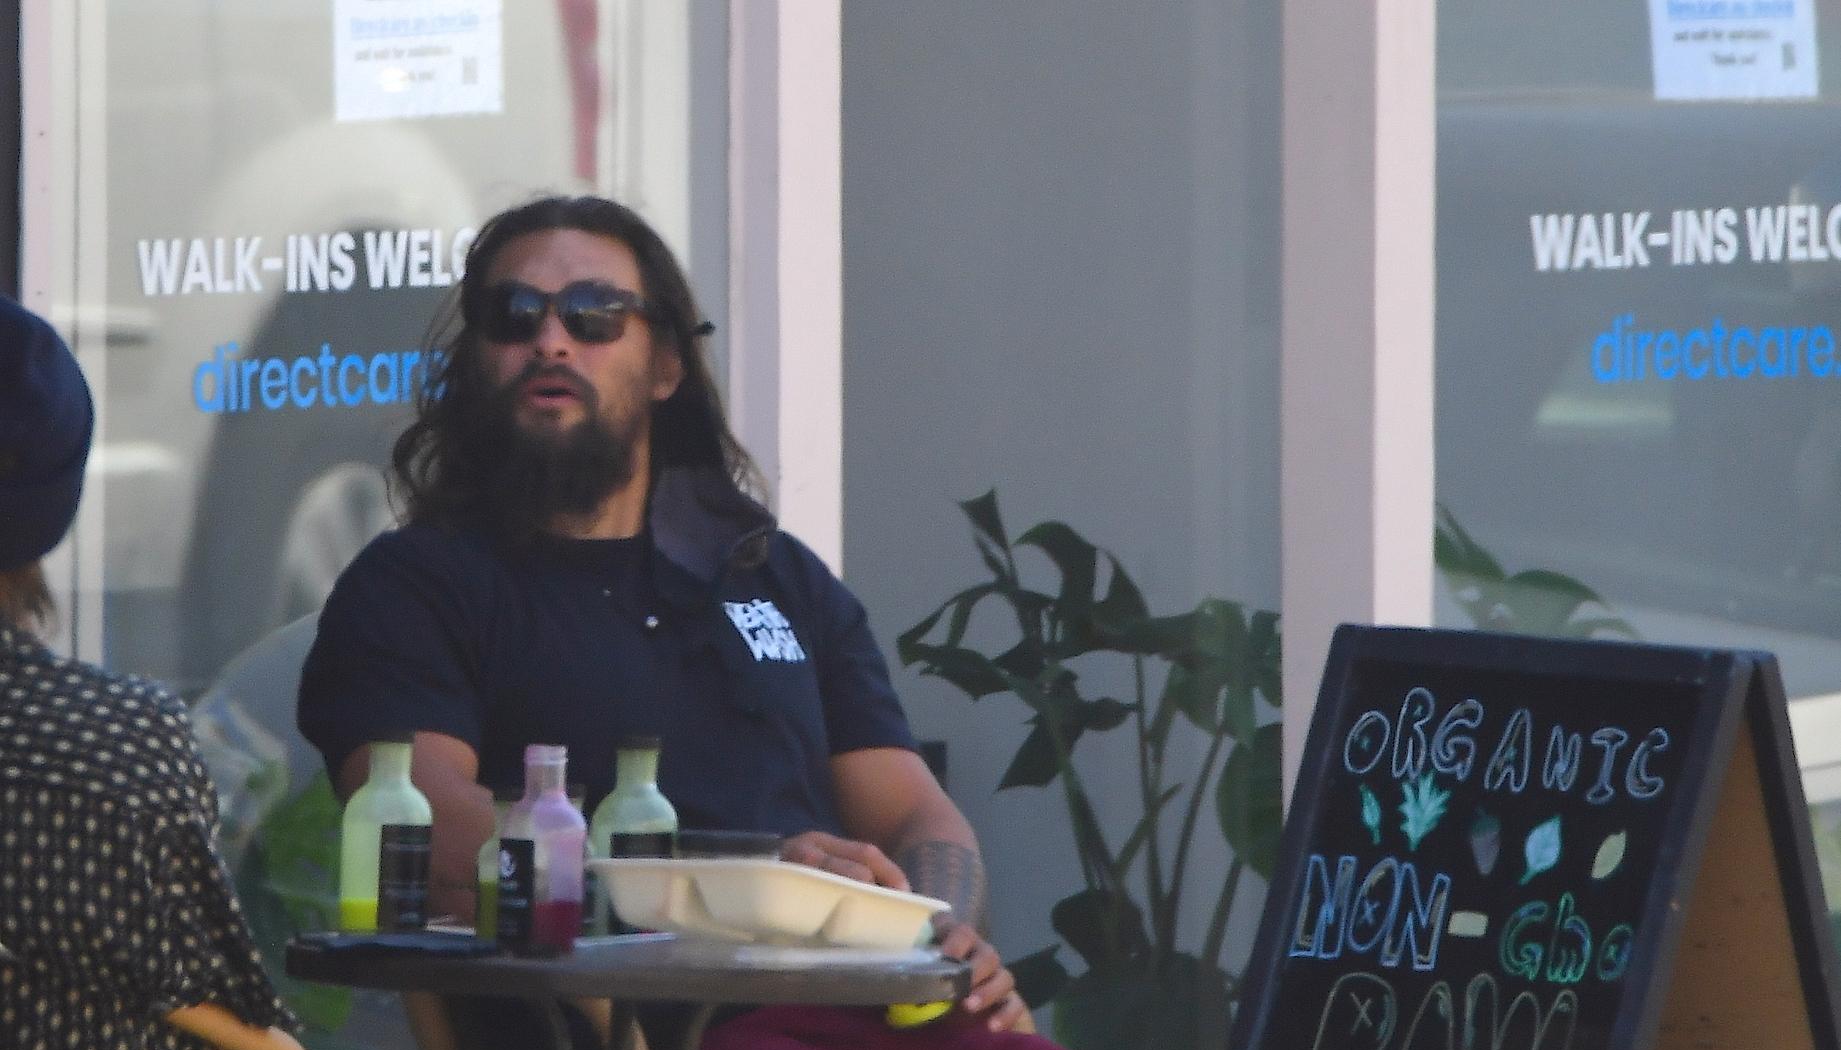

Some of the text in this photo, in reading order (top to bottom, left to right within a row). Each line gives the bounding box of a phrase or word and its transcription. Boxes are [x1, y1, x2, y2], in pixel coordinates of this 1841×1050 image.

[138, 231, 357, 296] WALK-INS
[1529, 207, 1738, 272] WALK-INS
[1344, 686, 1670, 803] ORGANIC
